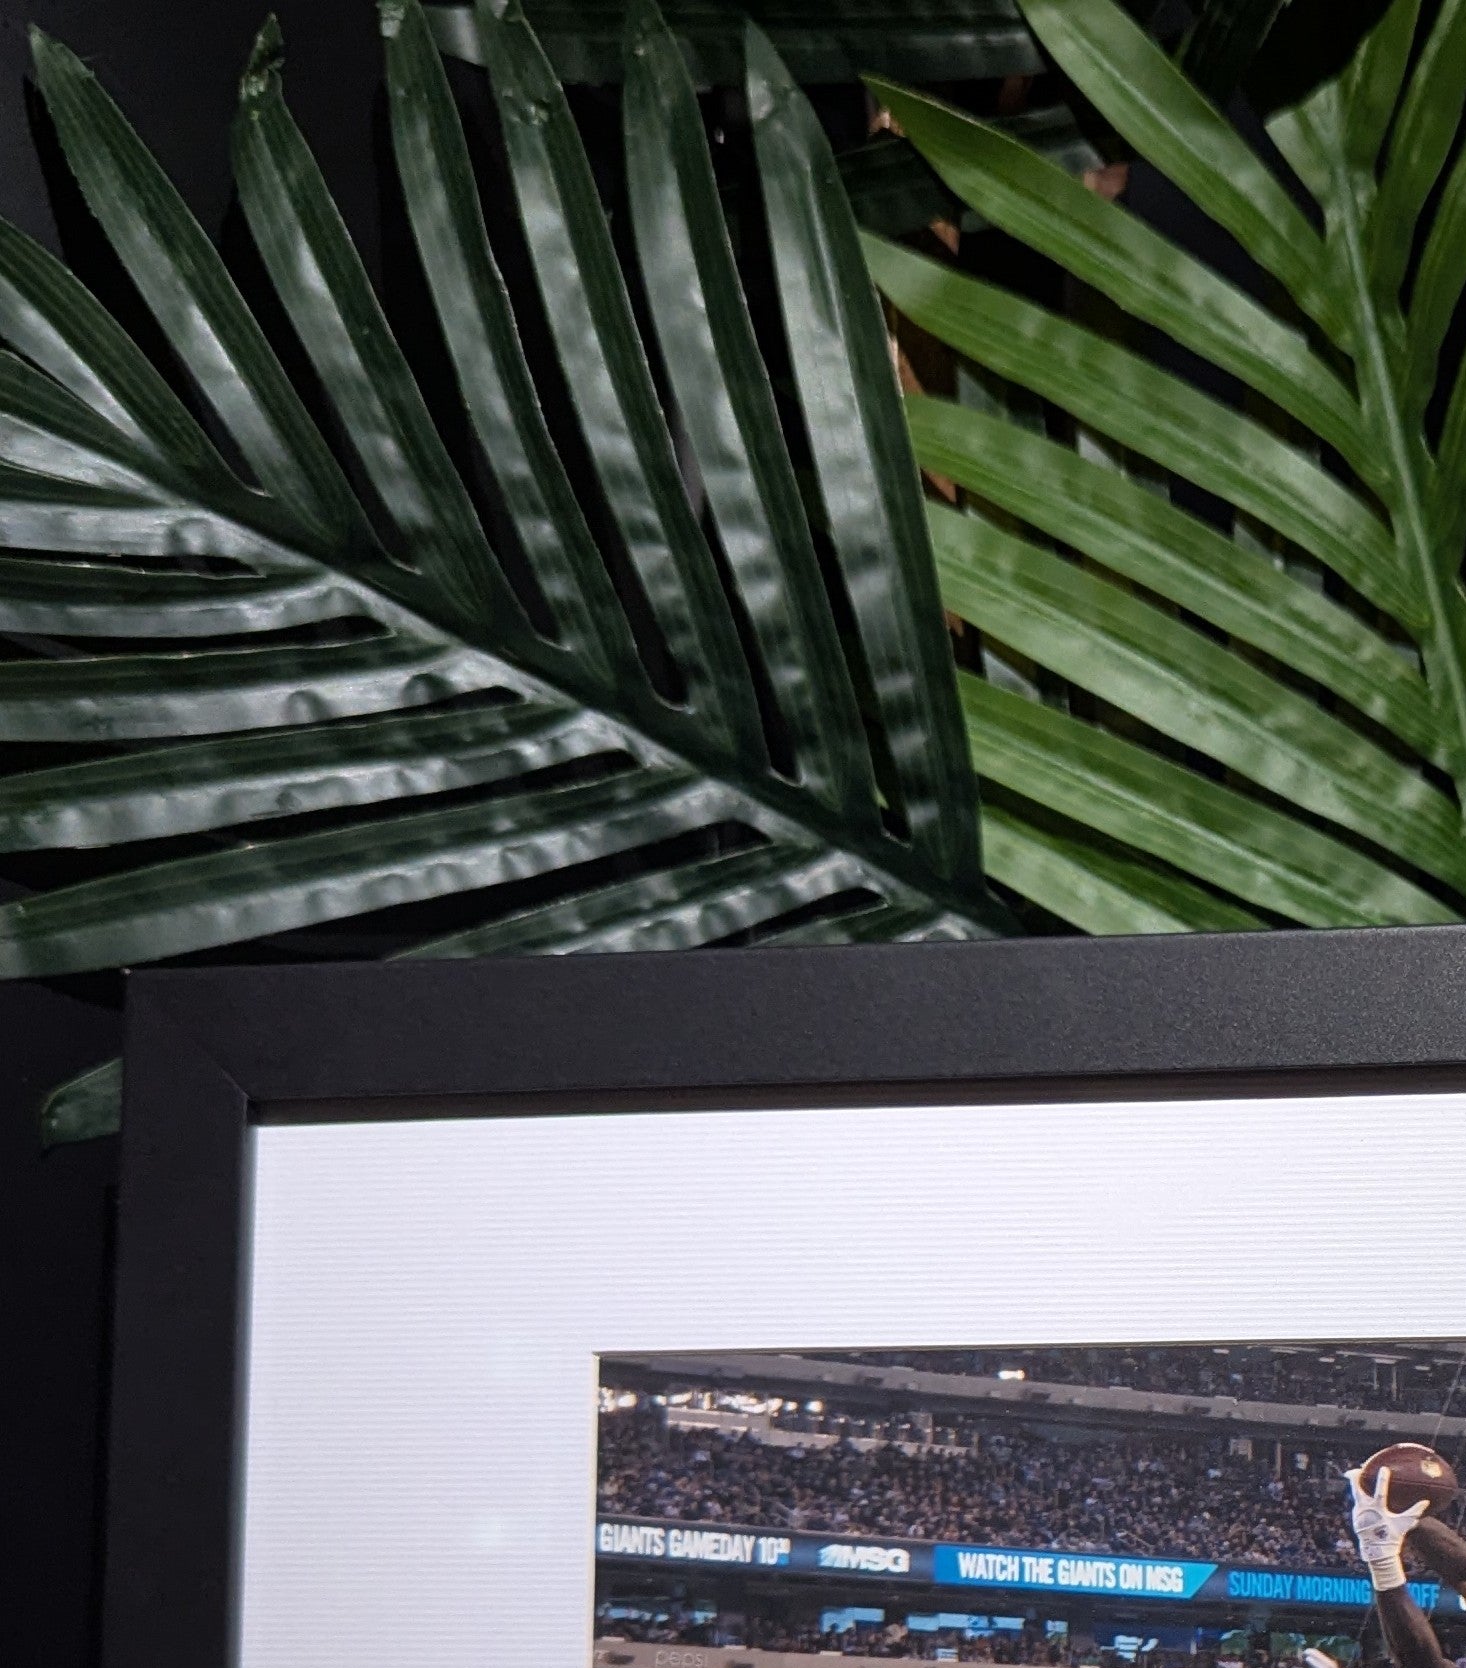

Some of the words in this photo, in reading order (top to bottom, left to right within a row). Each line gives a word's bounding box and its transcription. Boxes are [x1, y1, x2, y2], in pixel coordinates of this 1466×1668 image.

[599, 1522, 665, 1556] GIANTS
[669, 1529, 755, 1563] GAMEDAY
[839, 1545, 910, 1573] MSG
[957, 1551, 1019, 1582] WATCH
[1022, 1556, 1055, 1584] THE
[1057, 1558, 1116, 1589] GIANTS
[1119, 1562, 1143, 1591] ON
[1145, 1564, 1184, 1593] MSG
[1227, 1571, 1295, 1599] SUNDAY
[1297, 1574, 1371, 1605] MORNING
